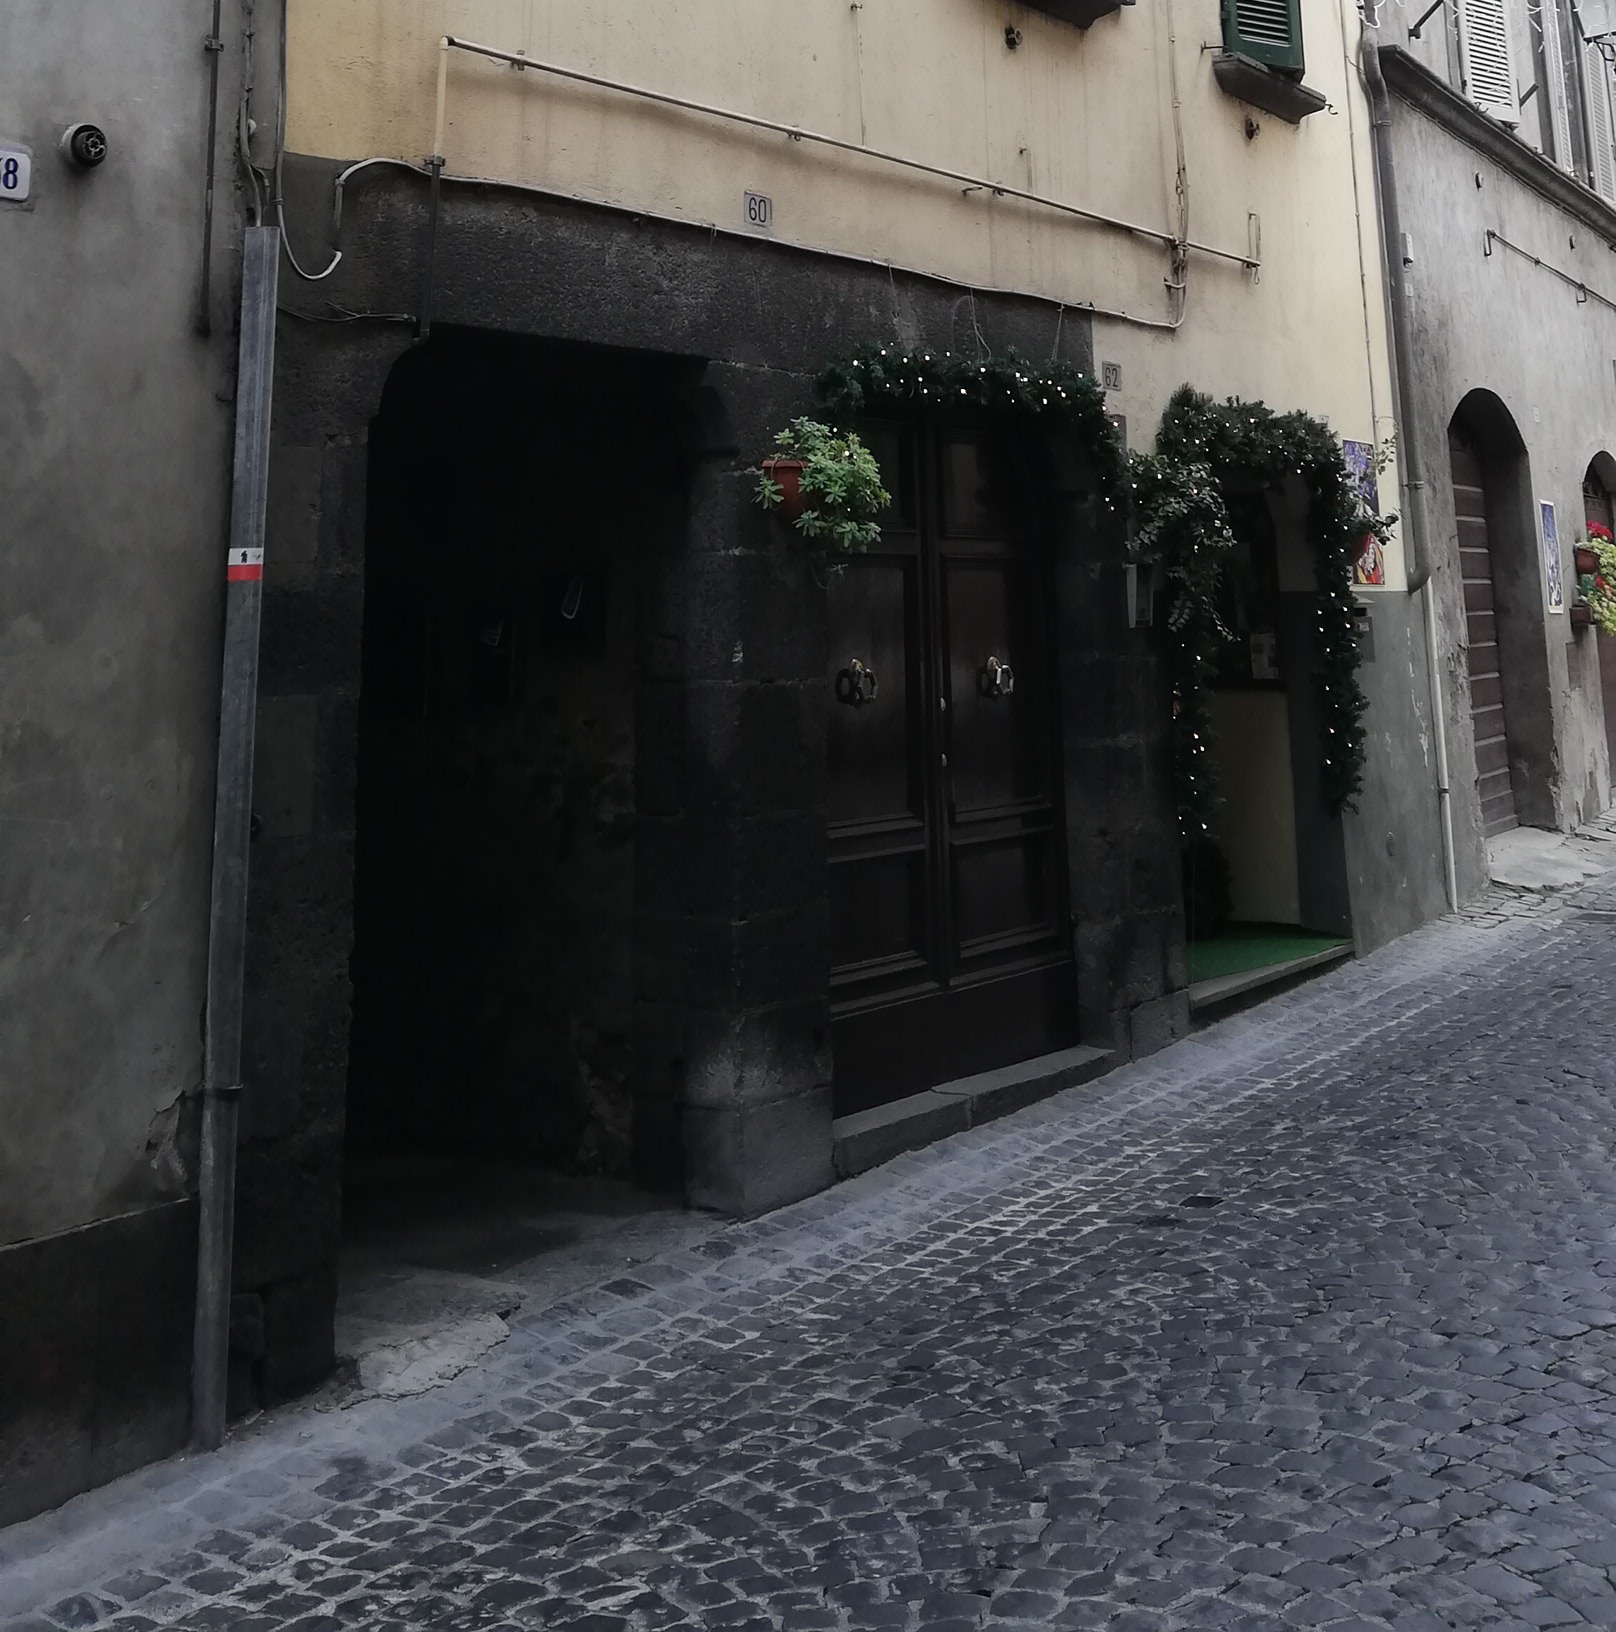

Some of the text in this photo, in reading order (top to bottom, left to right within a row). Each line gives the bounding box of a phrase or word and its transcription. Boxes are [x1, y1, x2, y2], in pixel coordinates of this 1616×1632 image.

[0, 156, 19, 190] 8
[748, 196, 767, 223] 60
[1104, 366, 1119, 388] 62
